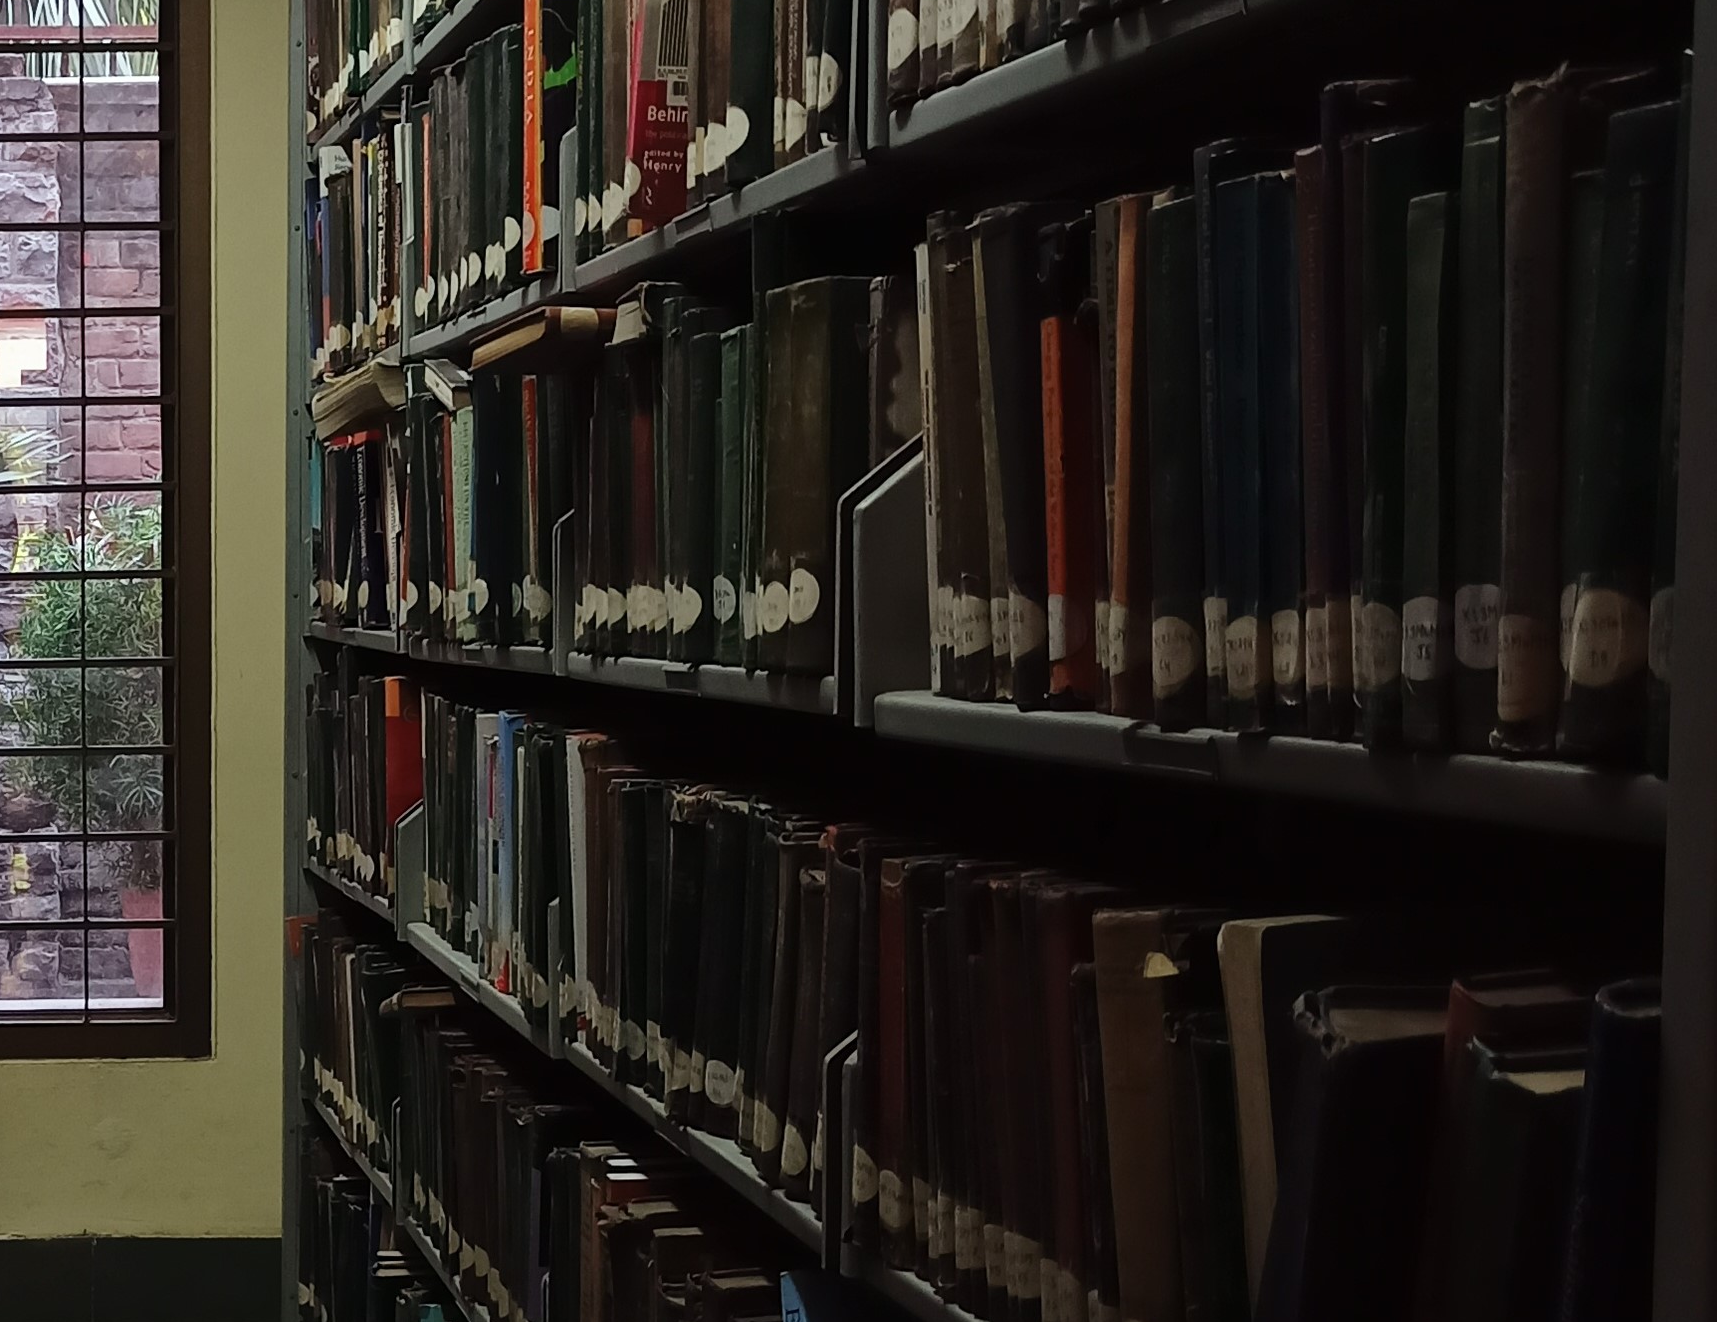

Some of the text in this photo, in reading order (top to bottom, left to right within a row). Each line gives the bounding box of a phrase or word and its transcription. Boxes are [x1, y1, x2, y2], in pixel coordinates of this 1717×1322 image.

[526, 27, 535, 125] INDIA
[674, 150, 684, 160] by
[643, 159, 682, 174] Henry
